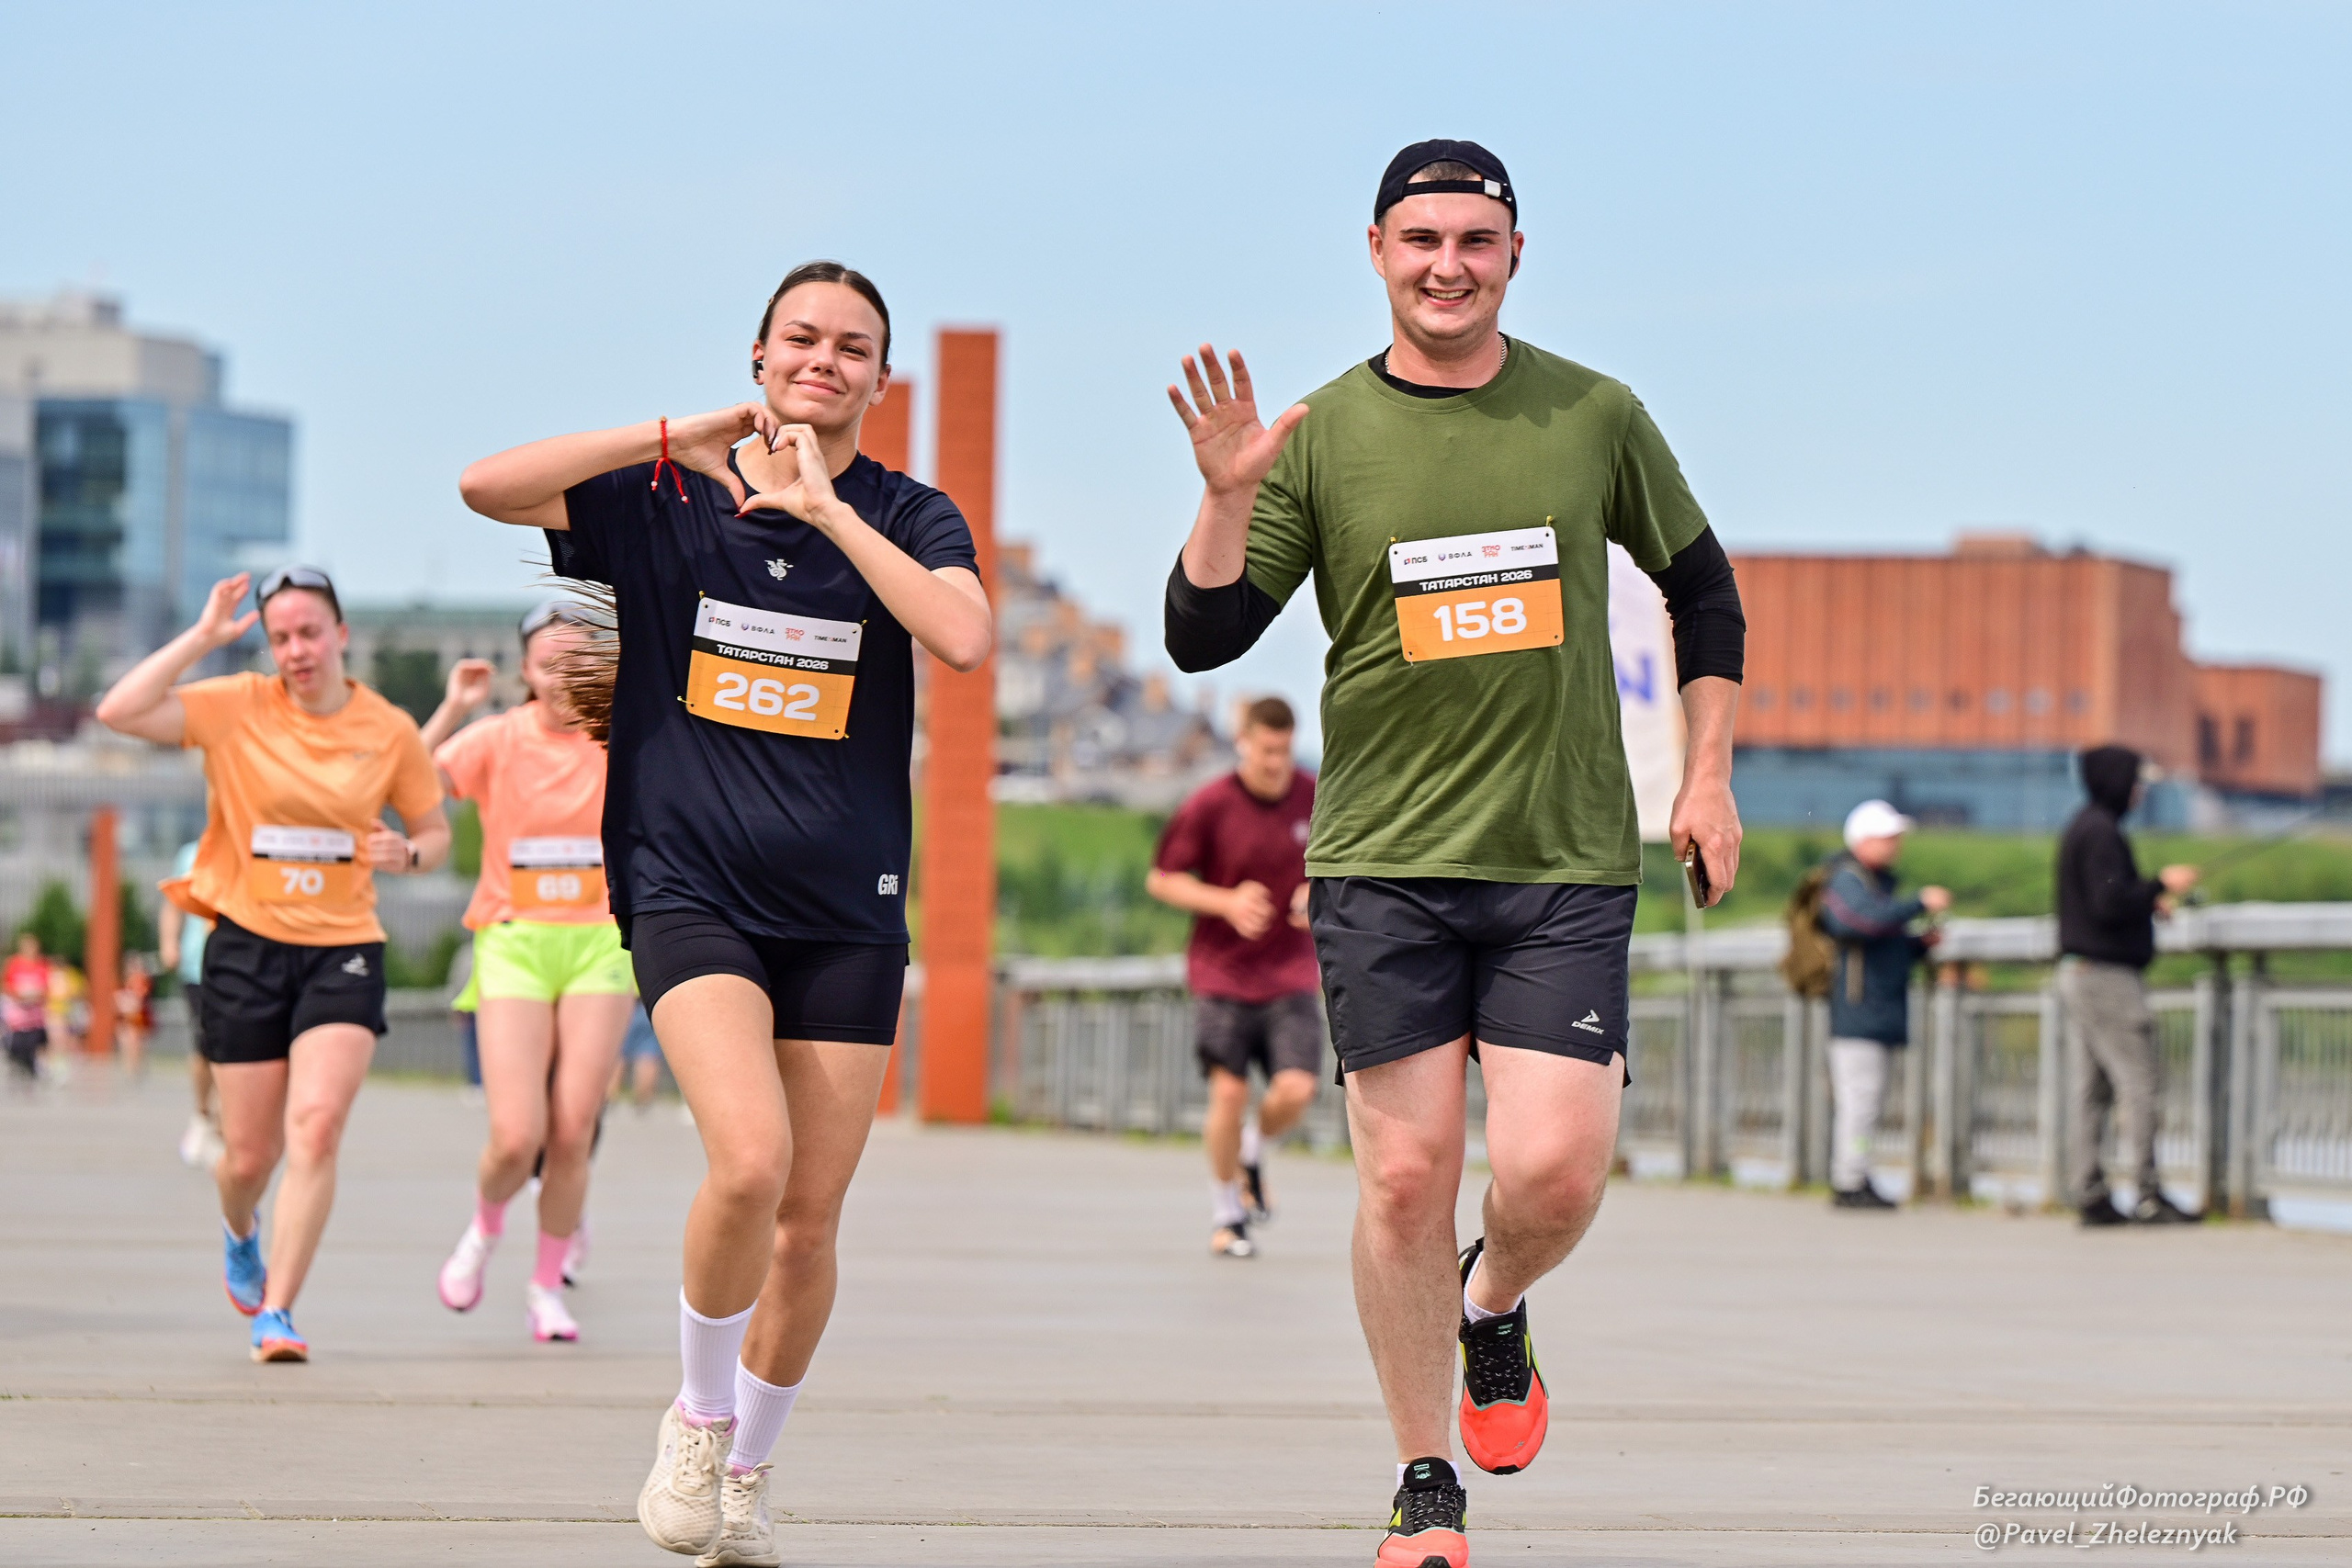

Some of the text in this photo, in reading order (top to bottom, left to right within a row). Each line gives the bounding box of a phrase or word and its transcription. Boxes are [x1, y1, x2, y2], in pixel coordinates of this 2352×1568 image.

[1411, 556, 1428, 564] ПСБ
[1419, 570, 1532, 592] ТАТАРСТАН 2026
[716, 617, 731, 627] ПСБ
[1432, 597, 1527, 642] 158
[717, 644, 829, 671] ТАТАРСТАН 2026
[713, 671, 820, 721] 262
[279, 867, 324, 896] 70
[1571, 1021, 1604, 1035] DEMIX
